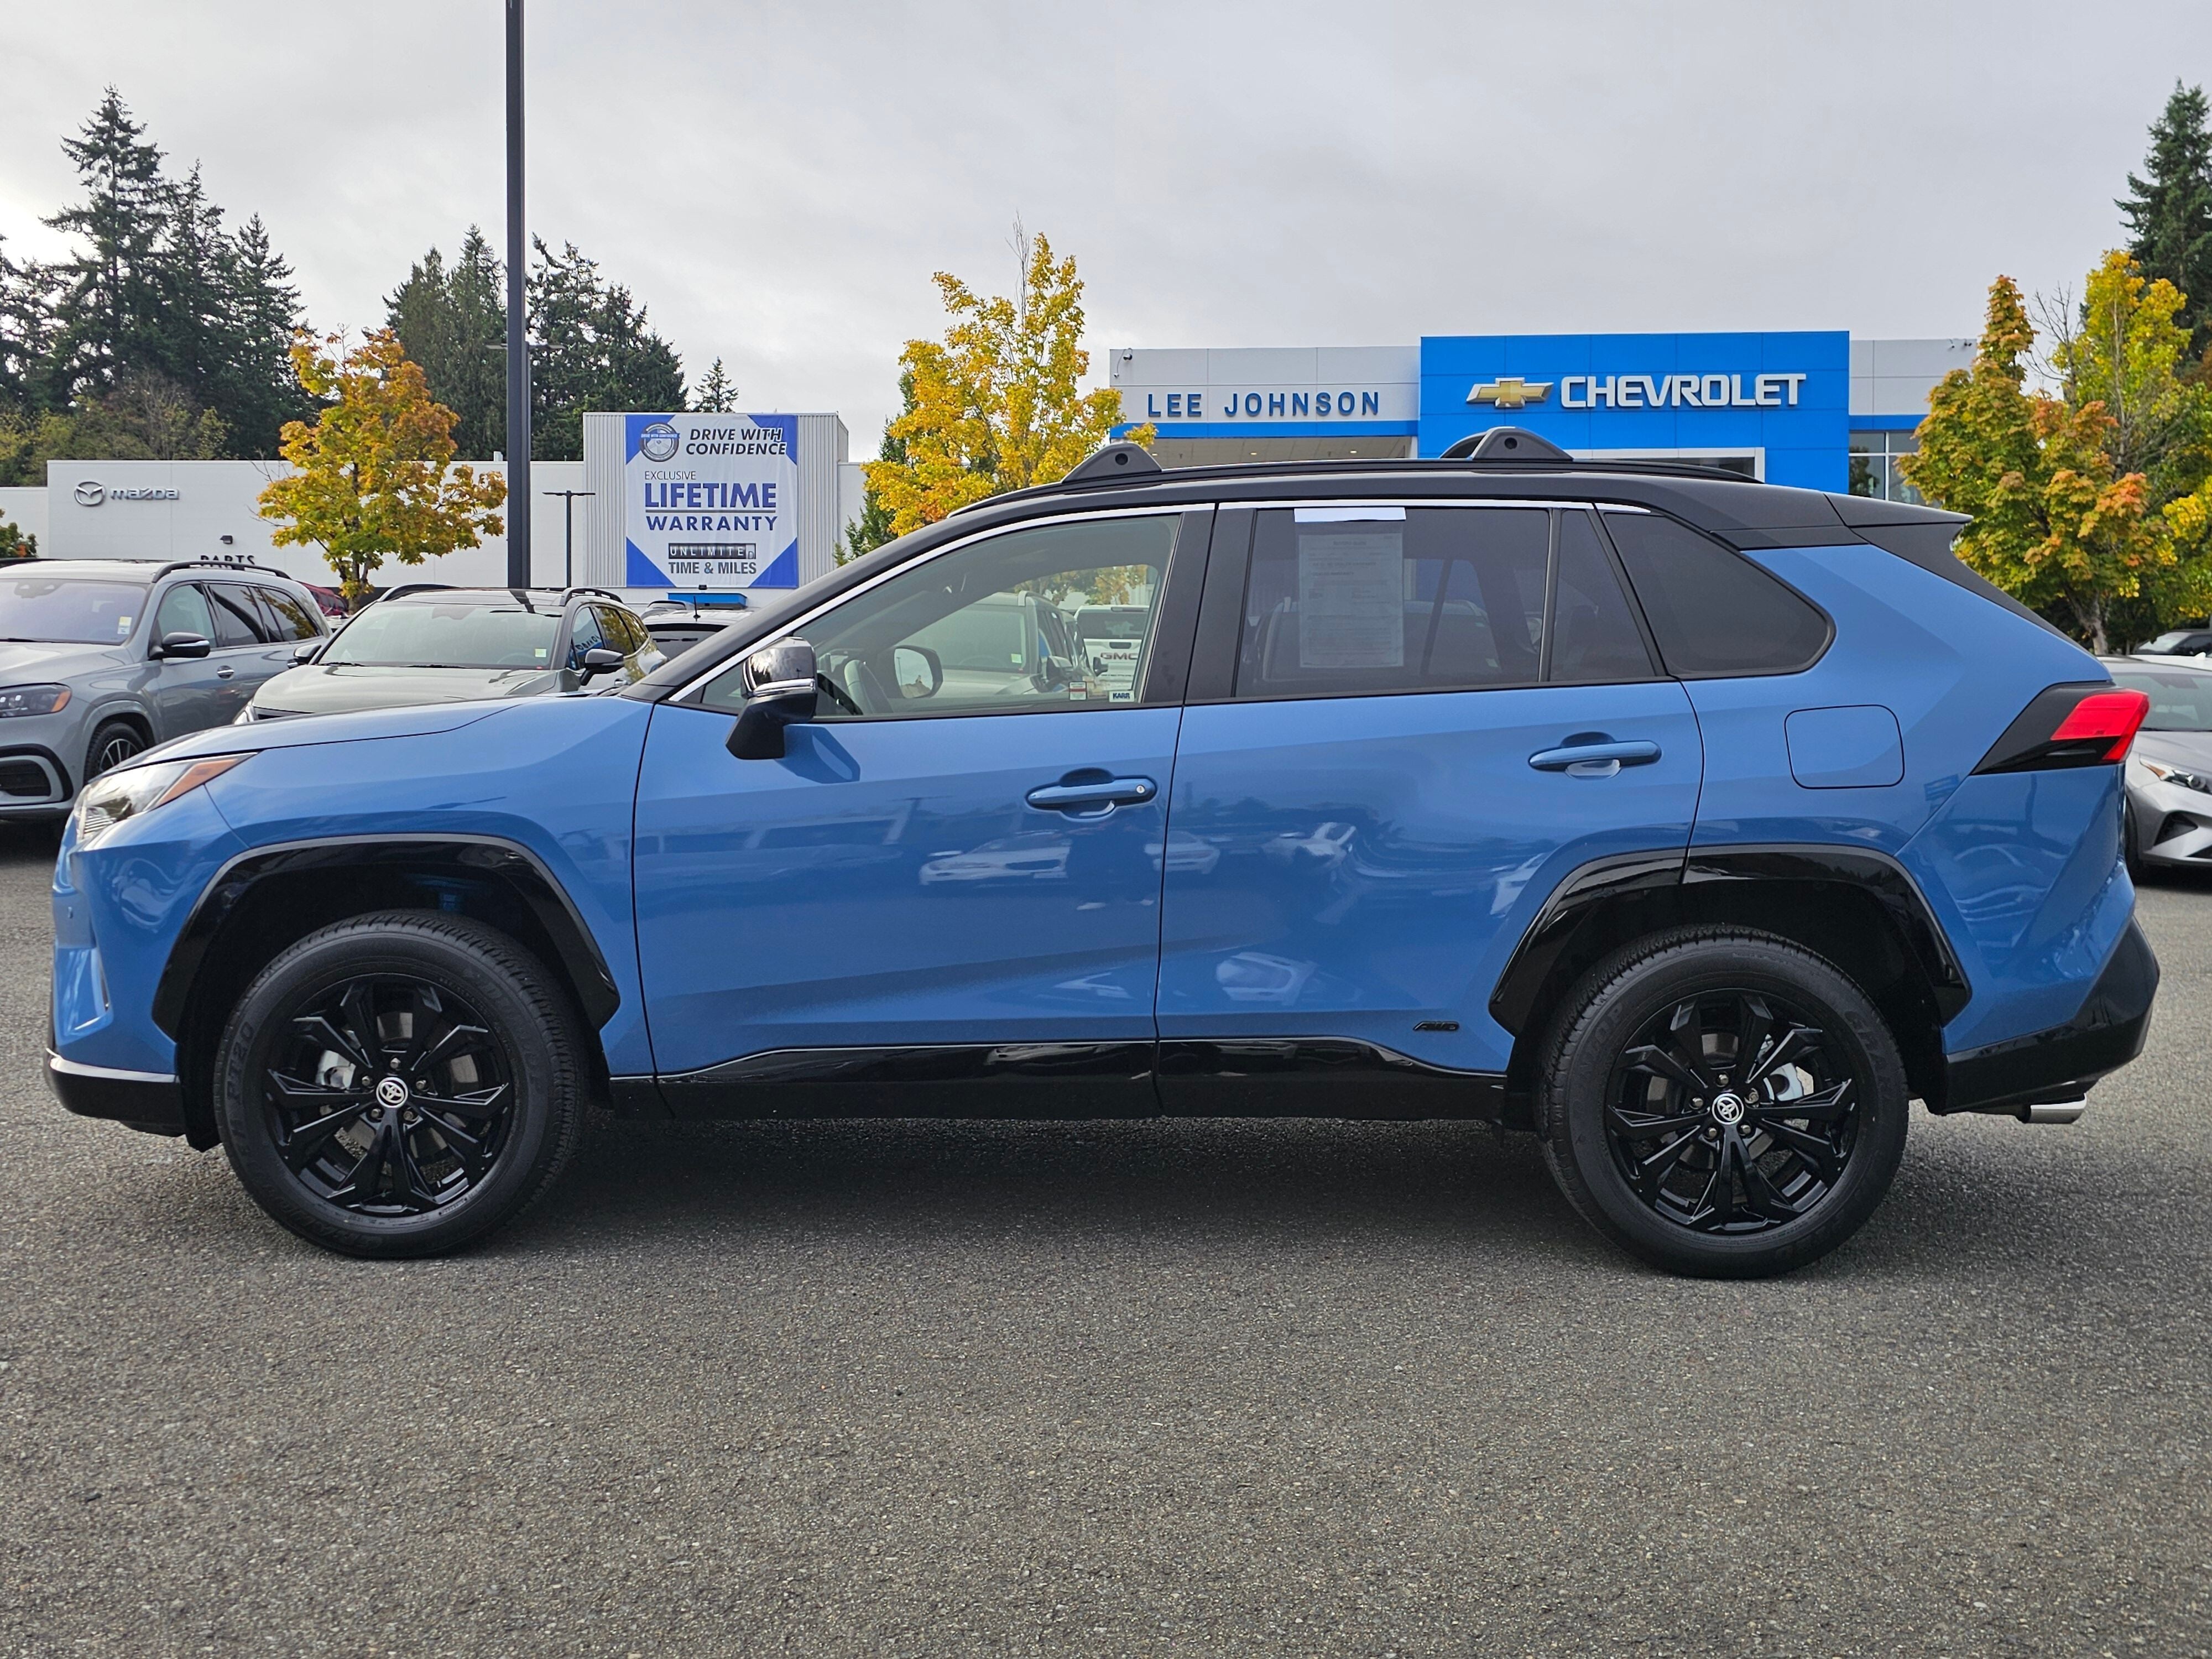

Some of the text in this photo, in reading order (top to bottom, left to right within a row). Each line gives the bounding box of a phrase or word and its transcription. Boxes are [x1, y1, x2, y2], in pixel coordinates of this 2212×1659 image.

[1561, 374, 1806, 408] CHEVROLET
[1148, 392, 1379, 418] LEE JOHNSON
[690, 428, 782, 441] DRIVE WITH
[686, 443, 786, 455] CONFIDENCE
[645, 471, 696, 480] EXCLUSIVE
[111, 488, 180, 500] mazda
[645, 483, 776, 508] LIFETIME
[646, 515, 778, 531] WARRANTY
[670, 546, 755, 559] UNLIMITED
[668, 562, 757, 574] TIME & MILES
